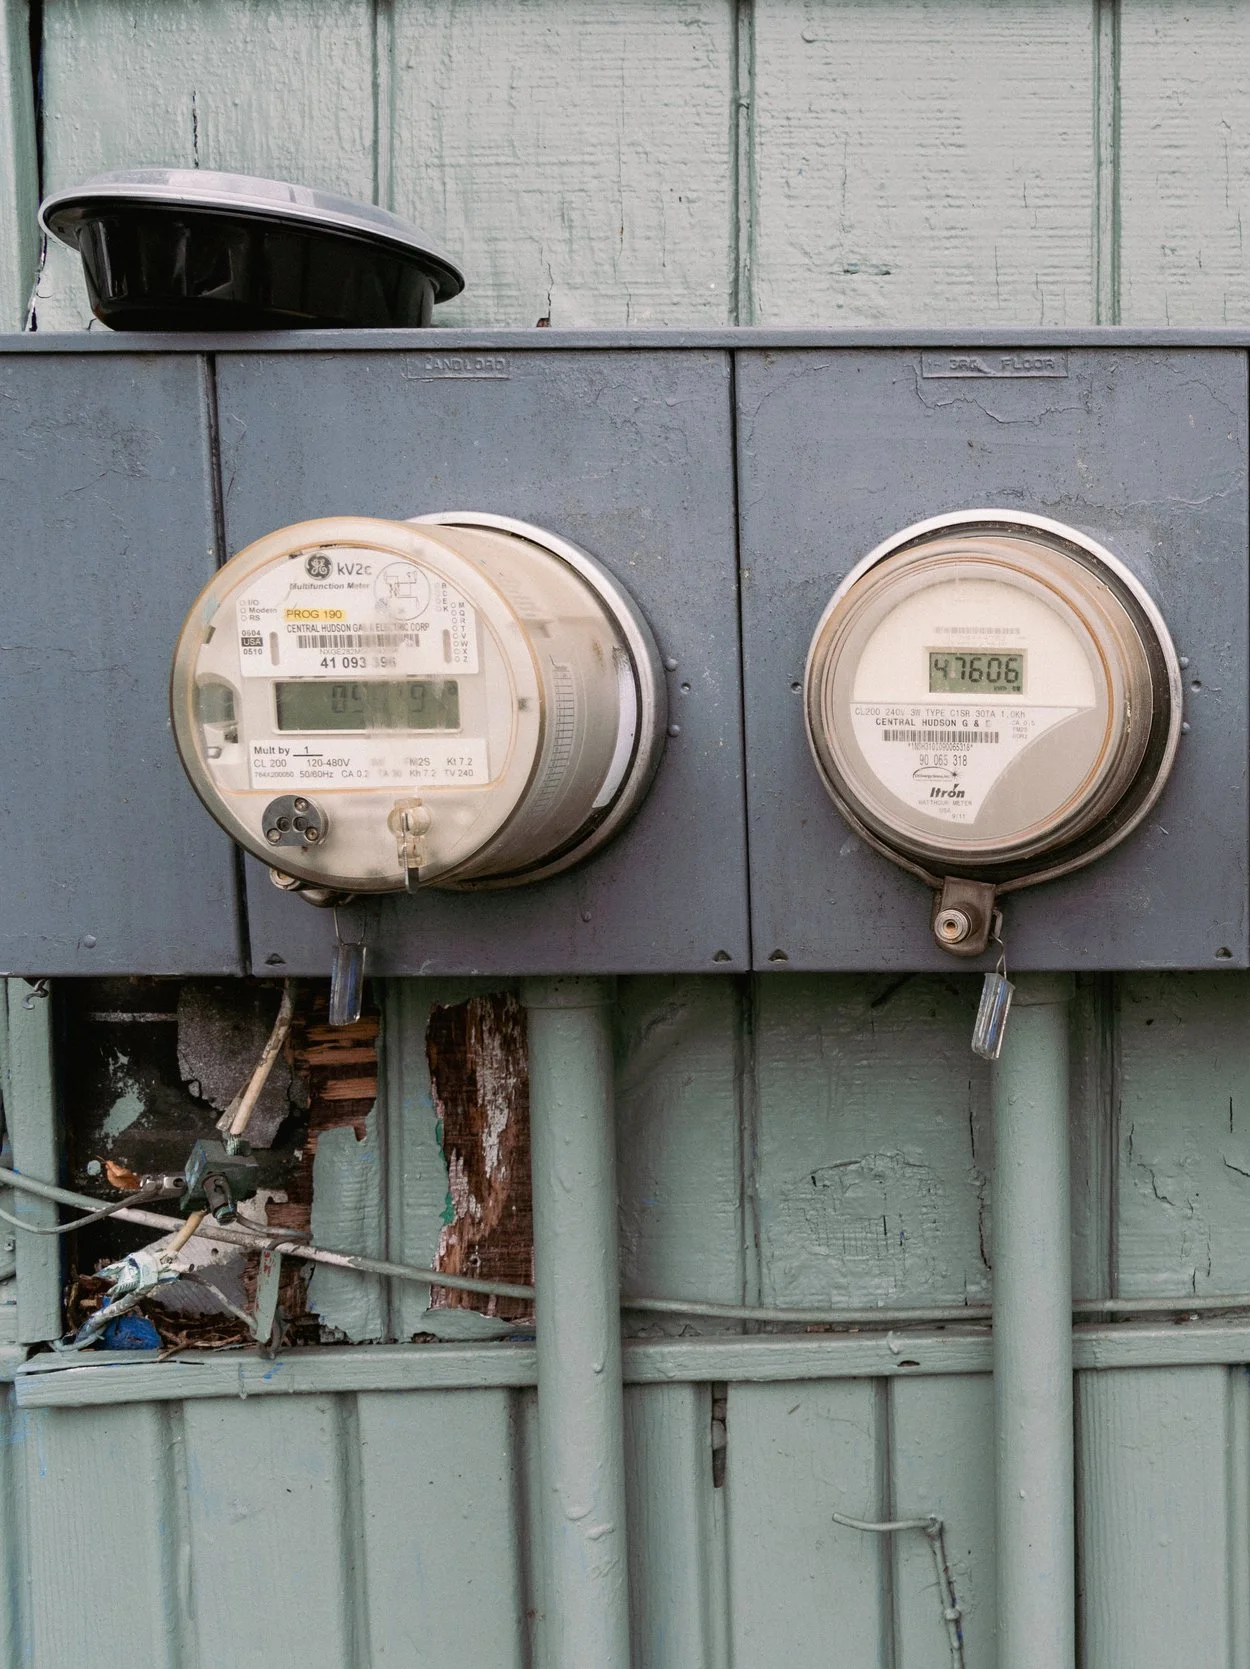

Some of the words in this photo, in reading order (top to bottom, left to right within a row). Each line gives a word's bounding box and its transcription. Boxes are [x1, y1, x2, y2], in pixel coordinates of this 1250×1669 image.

[1001, 356, 1055, 370] FLOOR
[337, 562, 372, 576] kV2c
[289, 582, 344, 590] Multifunction
[347, 582, 370, 590] Meter
[286, 609, 320, 619] PROG
[323, 610, 343, 619] 190
[287, 623, 320, 633] CENTRAL
[321, 623, 351, 633] HUDSON
[353, 623, 370, 632] GA
[376, 622, 409, 632] ELETRIC
[410, 622, 430, 632] CORP
[243, 637, 262, 647] USA
[320, 657, 336, 669] 41
[342, 656, 367, 669] 093
[934, 656, 1019, 684] 47606
[854, 707, 881, 716] CL200
[926, 708, 945, 717] TYPE
[875, 717, 916, 727] CENTRAL
[921, 718, 957, 727] HUDSON
[961, 719, 968, 727] G
[973, 719, 979, 727] &
[254, 746, 275, 755] Mult
[278, 746, 290, 756] by
[304, 746, 309, 754] 1
[253, 759, 266, 768] CL
[269, 759, 287, 768] 200
[306, 758, 350, 768] 120-480V
[447, 757, 457, 766] Kt
[459, 757, 473, 766] 7.2
[919, 753, 929, 766] 90
[933, 753, 948, 766] 065
[952, 754, 968, 767] 318
[299, 770, 334, 779] 50/60Hz
[341, 769, 354, 778] CA
[409, 769, 421, 777] Kh
[445, 769, 456, 777] TV
[457, 769, 474, 777] 240
